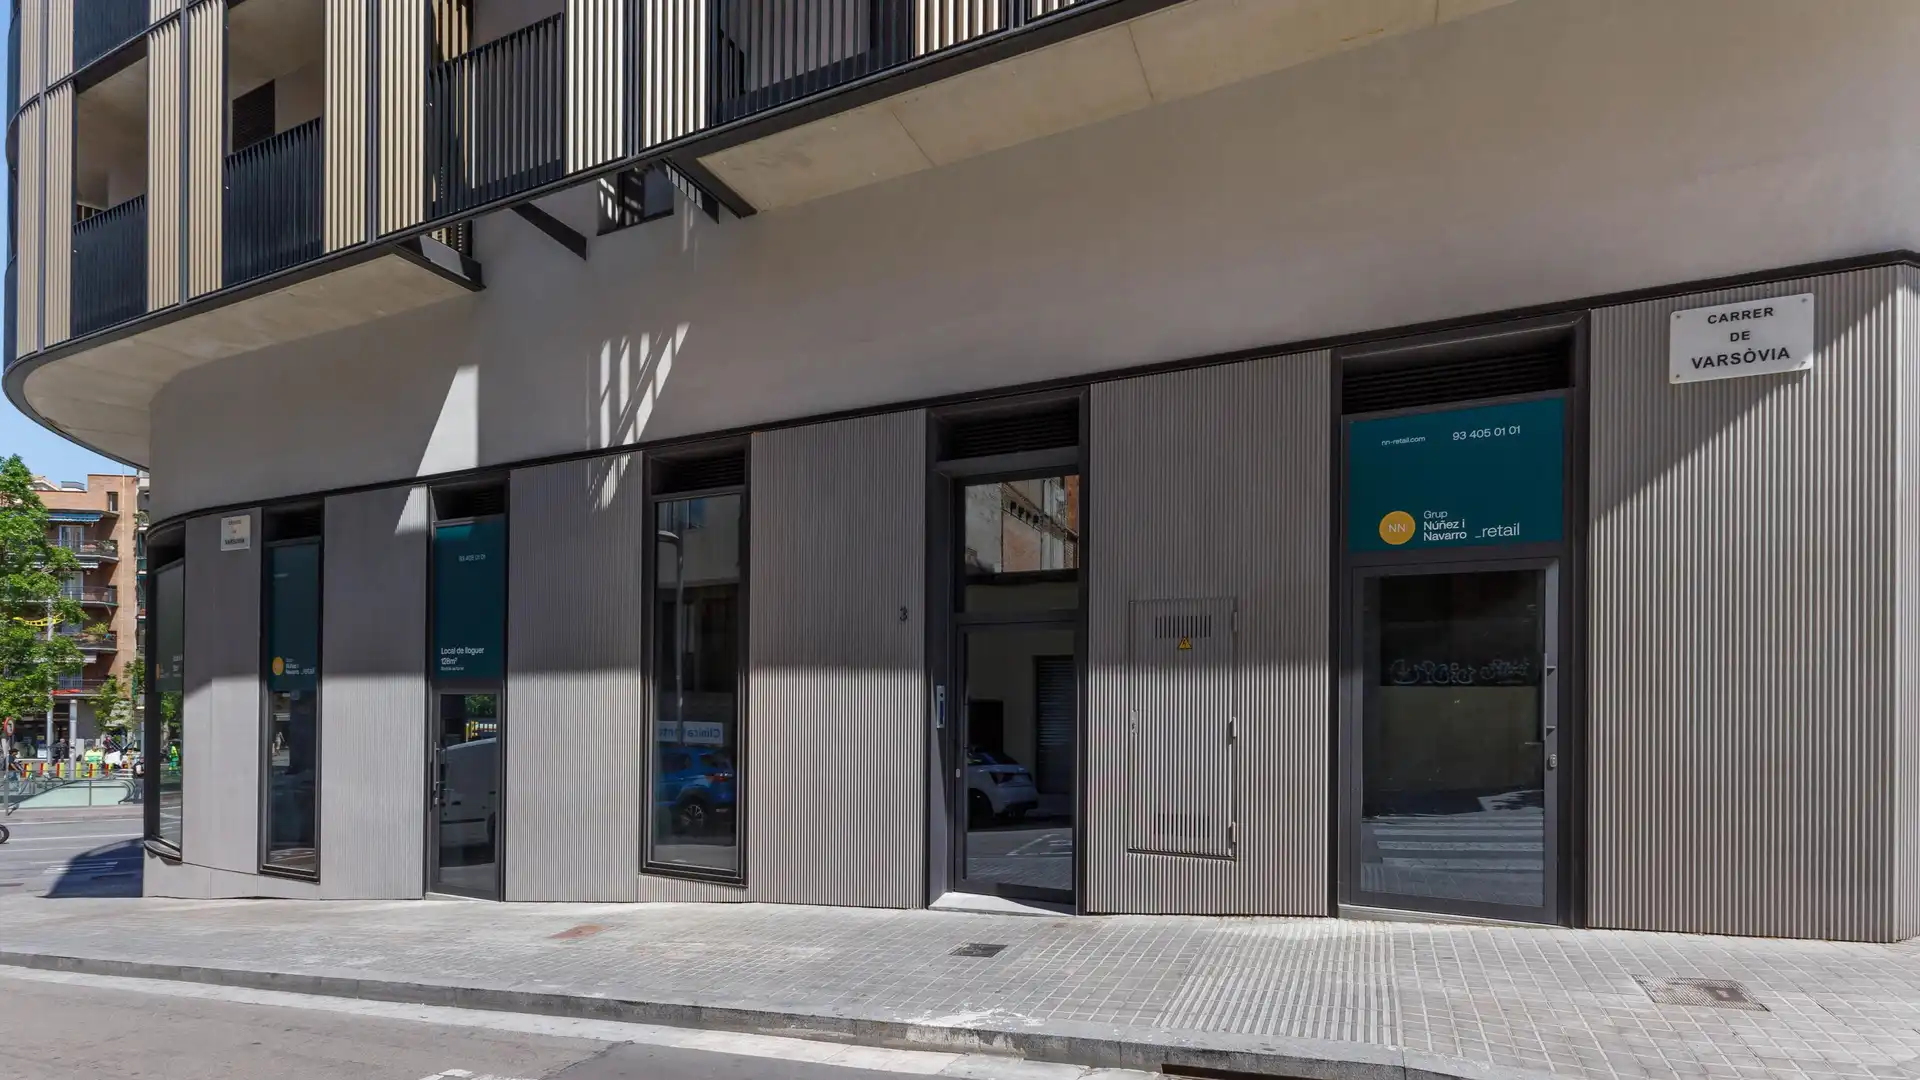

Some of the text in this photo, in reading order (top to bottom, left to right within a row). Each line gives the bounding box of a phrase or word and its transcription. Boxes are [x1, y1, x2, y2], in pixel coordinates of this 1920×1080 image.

[1707, 307, 1774, 324] CARRER
[1729, 330, 1751, 342] DE
[1691, 347, 1790, 369] VARSÒVIA
[1452, 425, 1521, 441] 93 405 01 01
[1381, 436, 1426, 446] nn-retail.com
[1423, 510, 1448, 520] Grup
[1388, 523, 1406, 533] NN
[1423, 519, 1460, 531] Núñez
[1423, 530, 1468, 541] Navarro
[440, 647, 456, 655] Local
